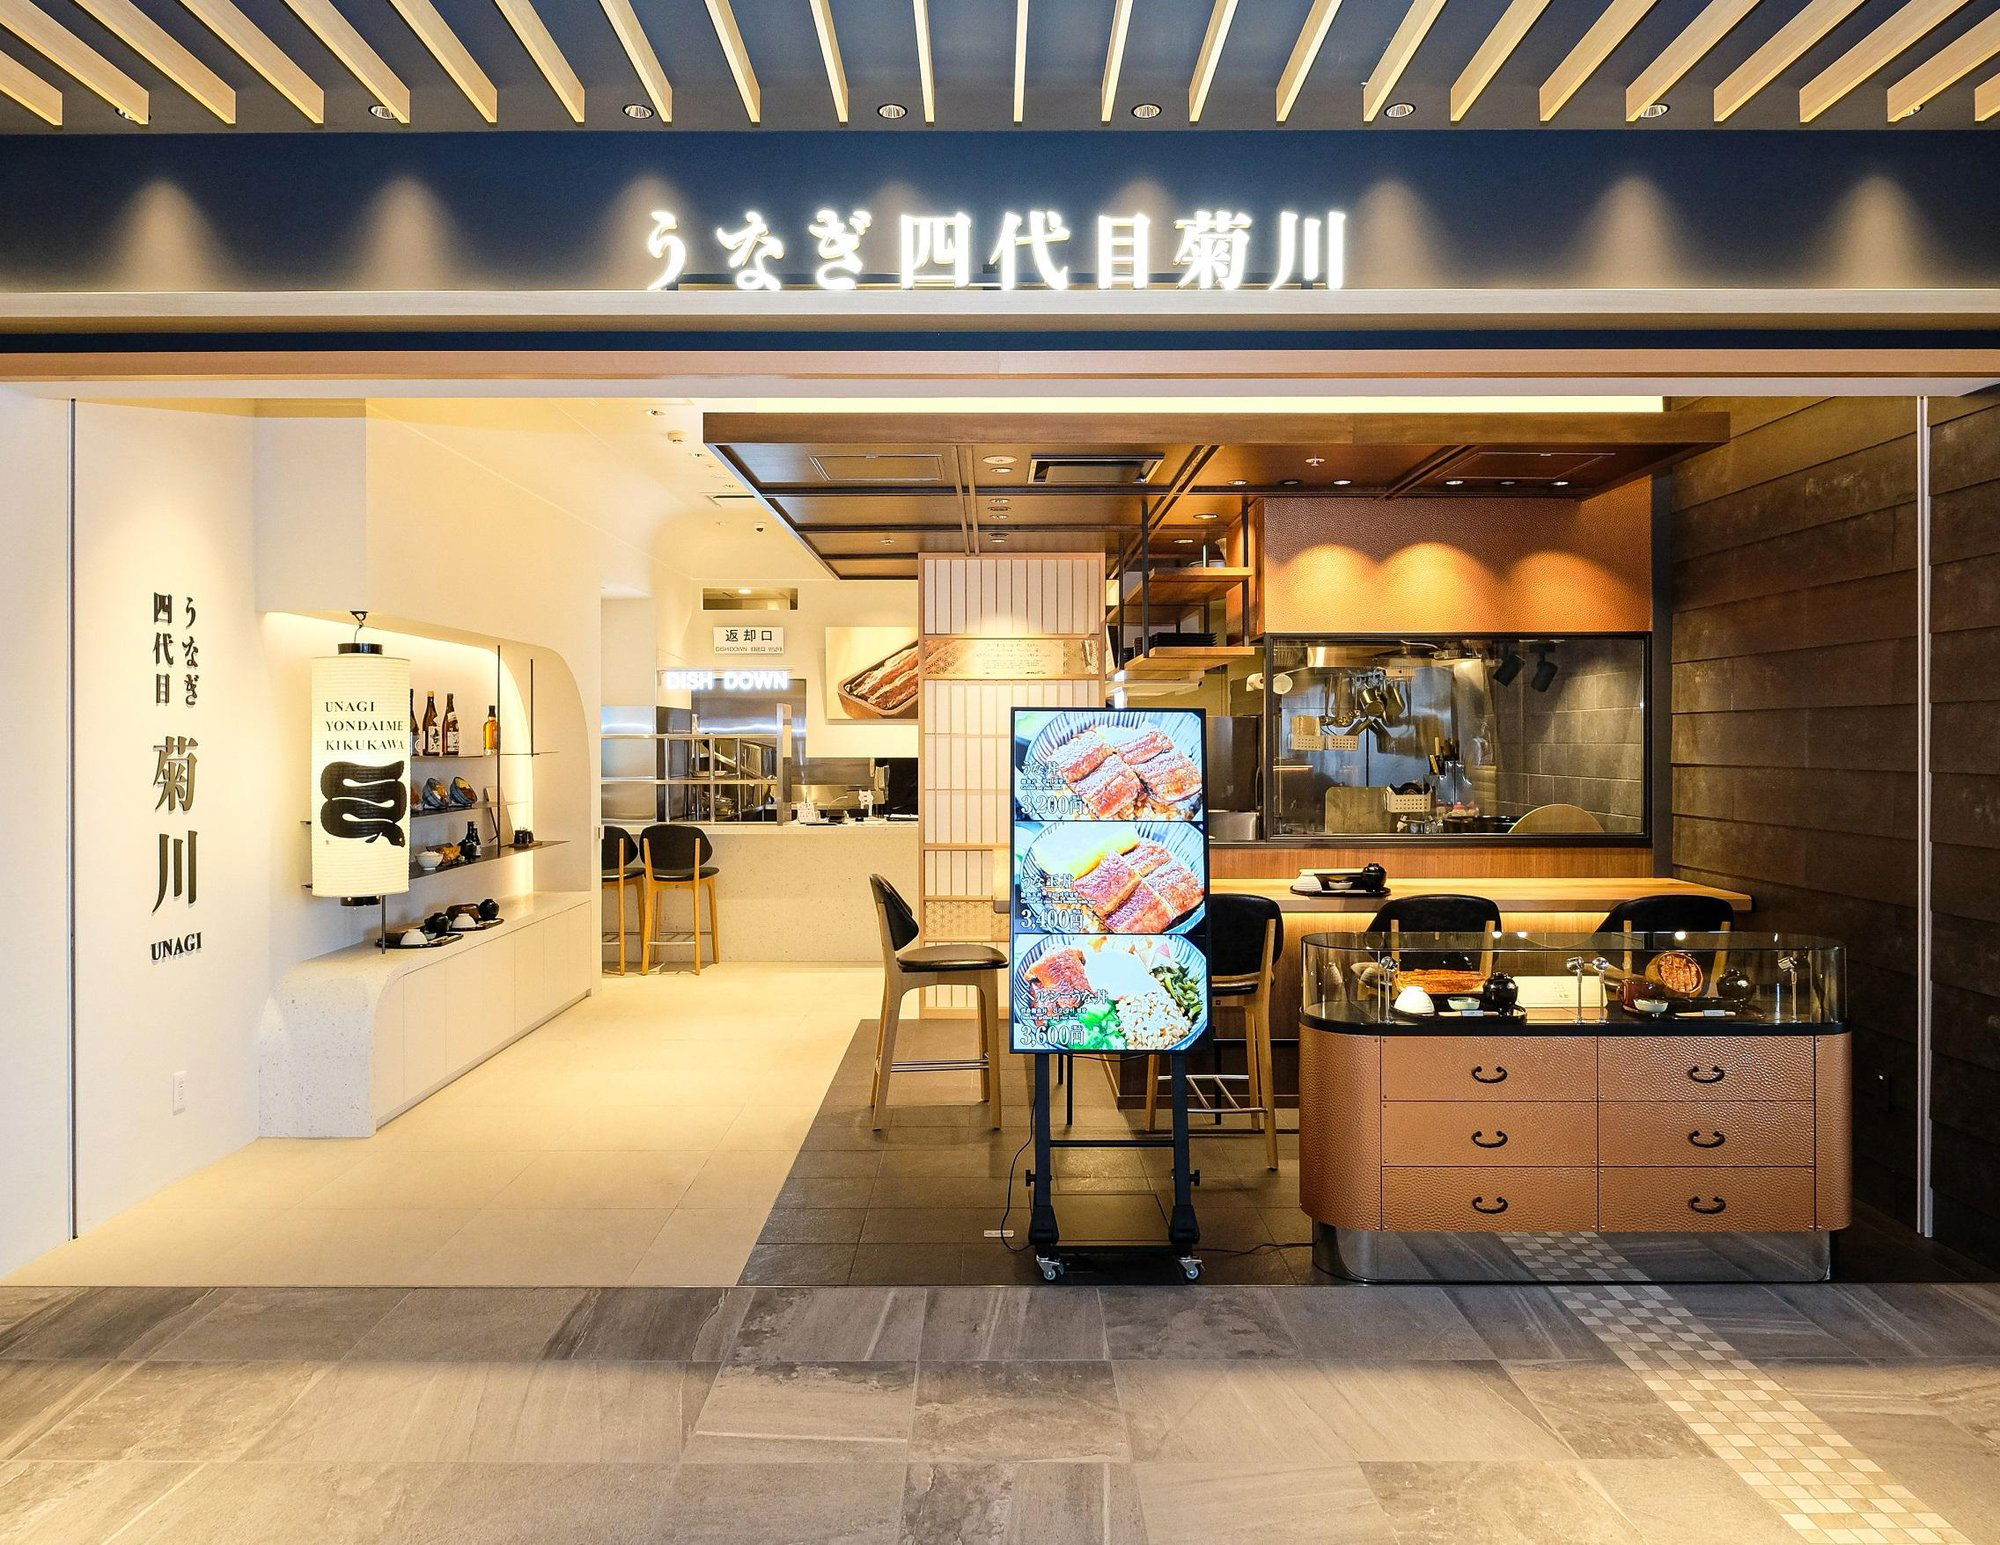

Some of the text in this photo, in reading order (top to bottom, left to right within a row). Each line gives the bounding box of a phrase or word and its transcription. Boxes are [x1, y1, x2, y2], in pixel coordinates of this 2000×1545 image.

[647, 210, 1347, 291] うなぎ四代目菊川
[725, 629, 773, 642] 返却口
[153, 592, 174, 705] 四代目
[181, 597, 199, 706] うなぎ
[666, 671, 788, 690] DISH DOWN
[325, 700, 375, 713] UNAGI
[325, 719, 404, 732] YONDAIME
[325, 739, 405, 751] KIKUKAWA
[152, 735, 199, 915] 菊川
[1020, 908, 1084, 930] 3,400円
[150, 931, 203, 961] UNAGI
[1022, 988, 1108, 1005] ヘルシーうな丼
[1020, 1024, 1086, 1047] 3,600円
